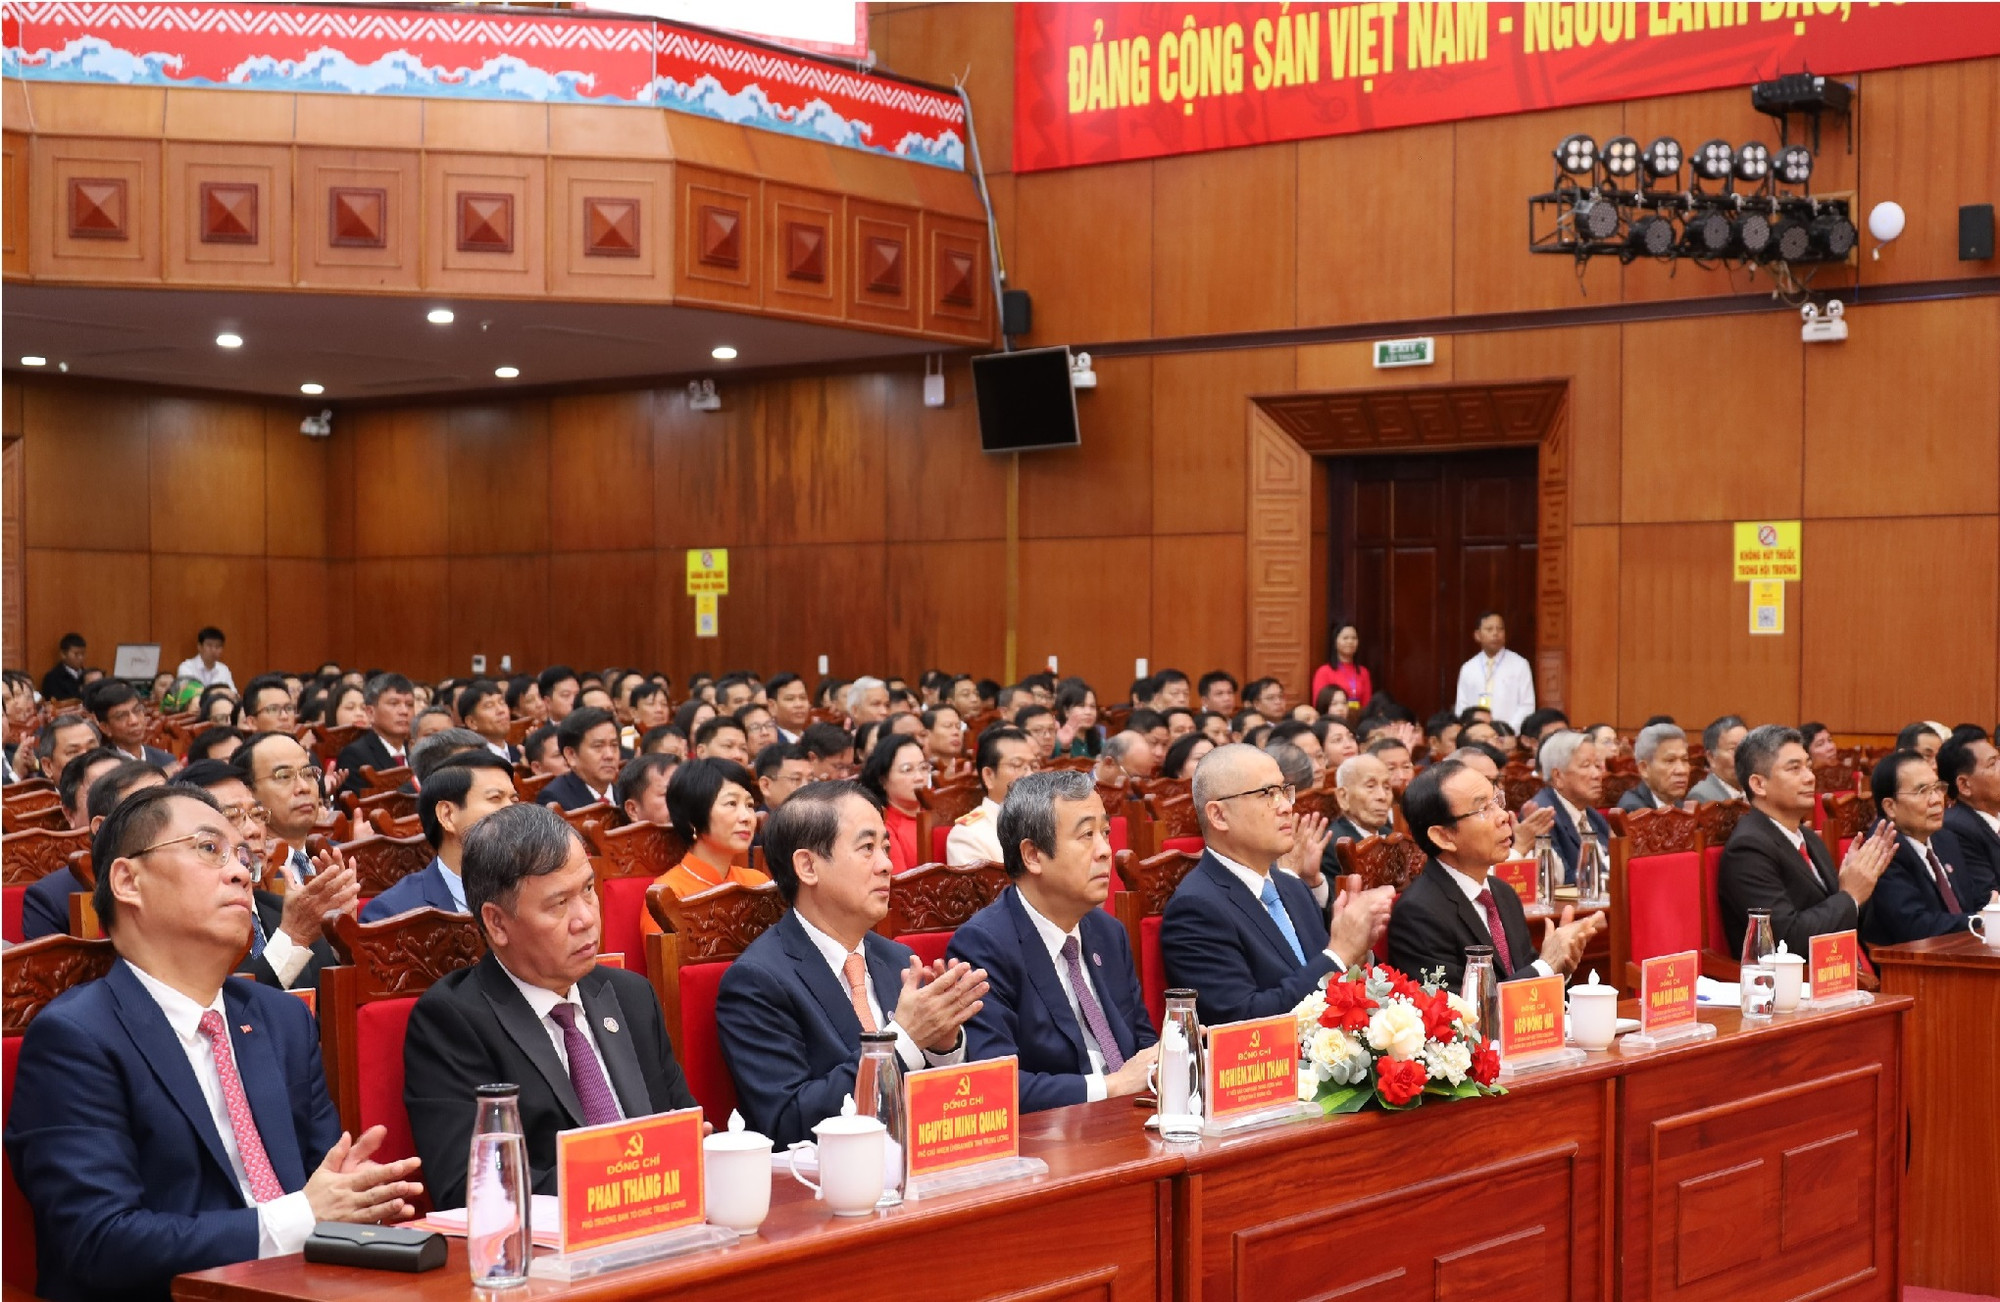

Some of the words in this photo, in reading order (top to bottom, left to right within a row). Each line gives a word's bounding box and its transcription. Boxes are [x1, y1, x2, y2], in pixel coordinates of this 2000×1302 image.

[1068, 18, 1150, 114] ĐẢNG
[1158, 15, 1243, 116] CỘNG
[1252, 2, 1320, 91] SẢN
[1407, 2, 1488, 70] NAM
[969, 1094, 984, 1106] CHÍ
[954, 1114, 977, 1138] MINH
[979, 1108, 1008, 1134] QUANG
[607, 1158, 639, 1175] ĐỒNG
[643, 1153, 660, 1167] CHÍ
[588, 1181, 620, 1213] PHAN
[664, 1169, 680, 1196] AN
